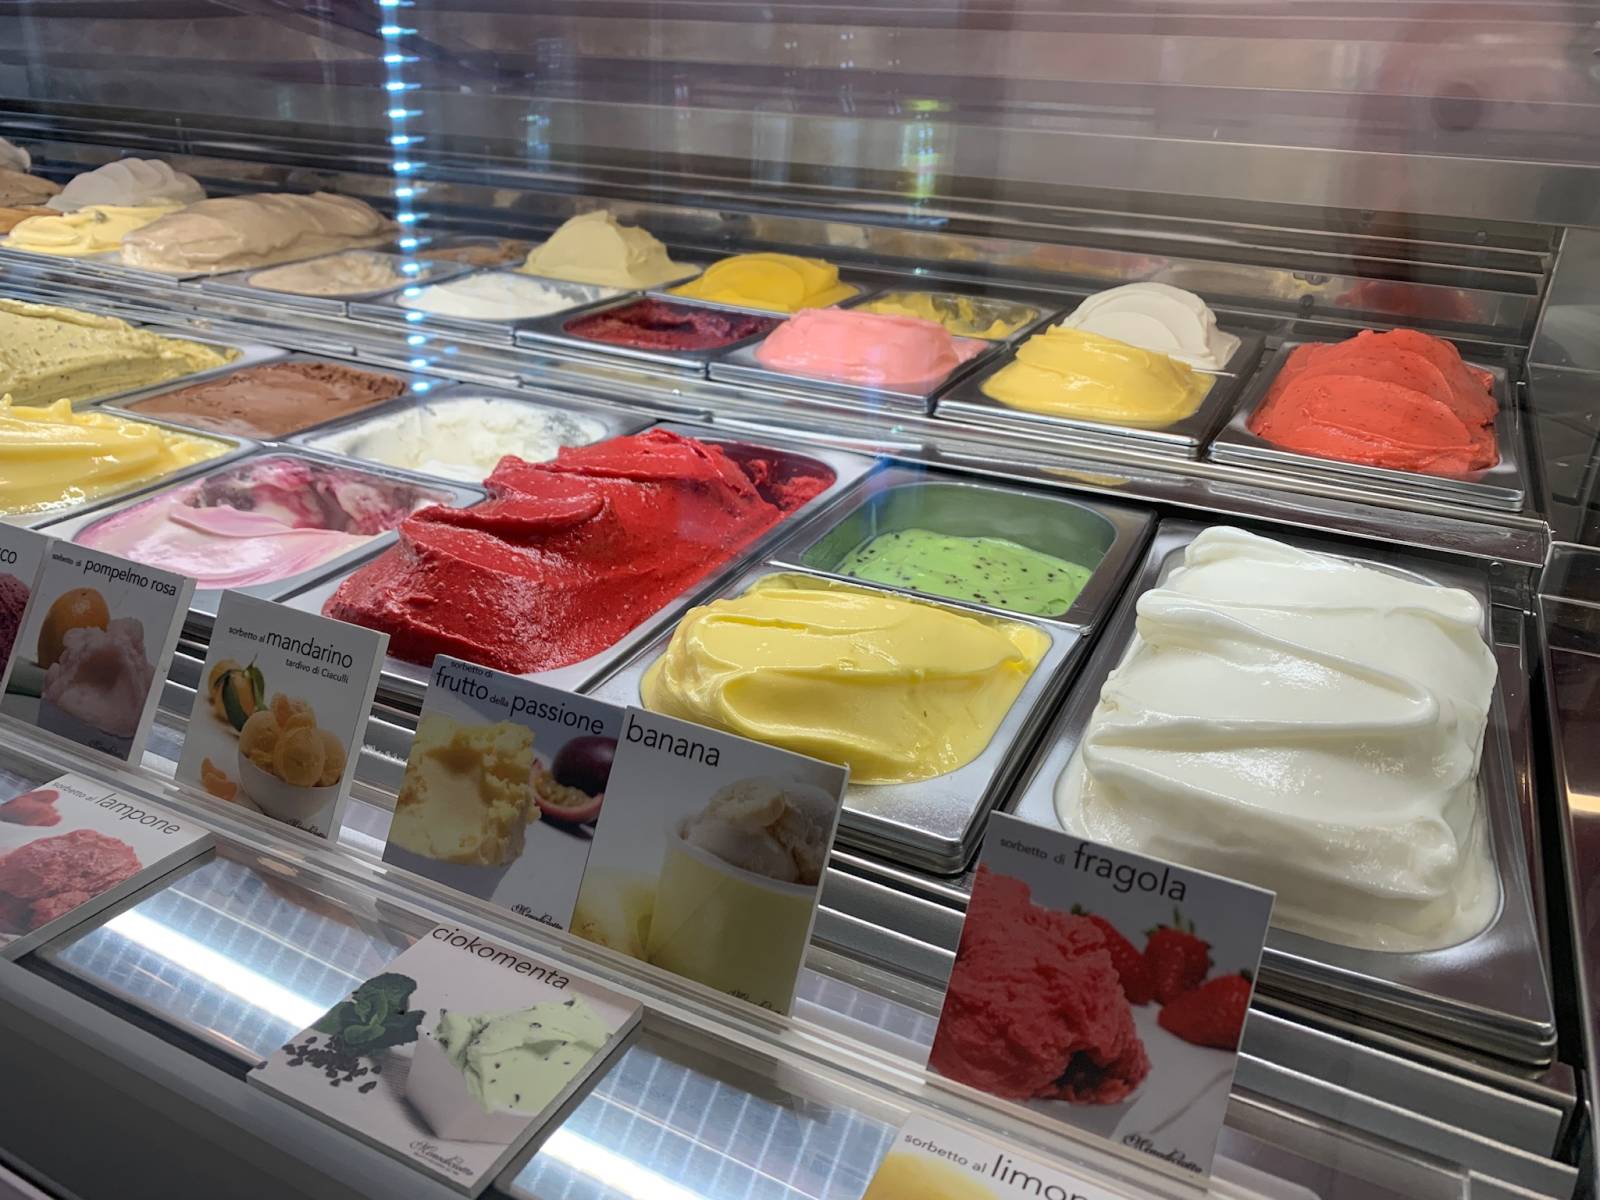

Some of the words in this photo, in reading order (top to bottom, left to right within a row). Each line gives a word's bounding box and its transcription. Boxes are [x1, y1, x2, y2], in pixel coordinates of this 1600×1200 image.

[83, 558, 149, 588] pompelmo
[150, 579, 177, 596] rosa
[228, 625, 258, 642] sorbetto
[258, 634, 266, 643] al
[266, 631, 353, 669] mandarino
[285, 658, 311, 673] tardivo
[312, 665, 320, 674] di
[450, 660, 484, 676] sorbetto
[484, 670, 494, 680] di
[435, 665, 489, 700] frutto
[489, 694, 510, 708] della
[509, 695, 605, 736] passione
[625, 714, 721, 768] banana
[95, 792, 182, 836] lampone
[999, 837, 1048, 860] sorbetto
[1053, 853, 1067, 865] di
[1073, 841, 1187, 902] fragola
[432, 927, 570, 990] ciokomenta
[904, 1133, 969, 1166] sorbetto
[972, 1162, 988, 1174] al
